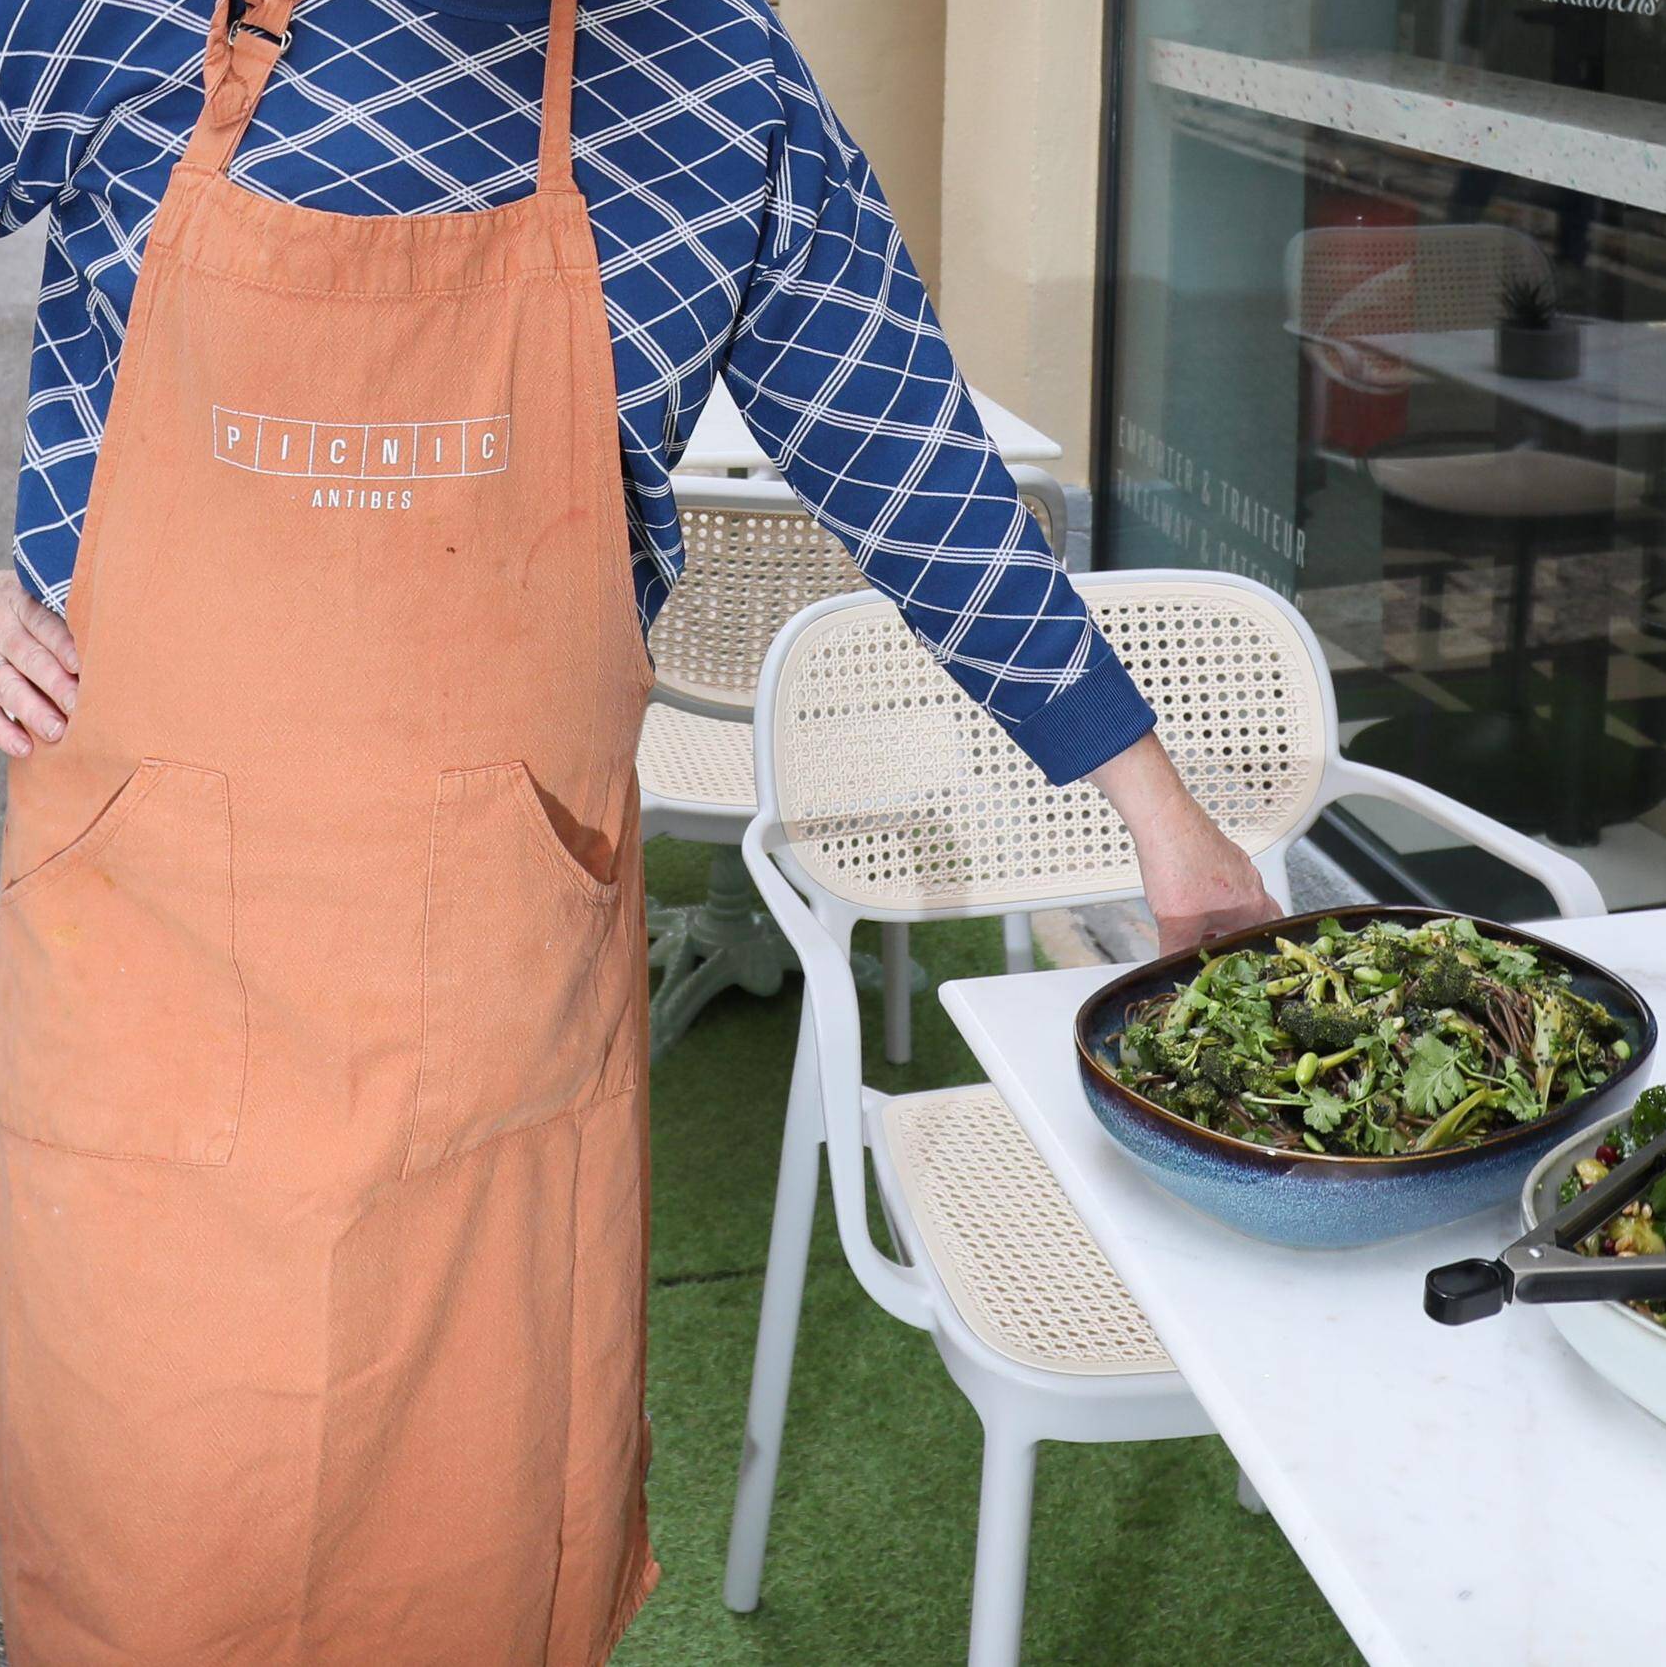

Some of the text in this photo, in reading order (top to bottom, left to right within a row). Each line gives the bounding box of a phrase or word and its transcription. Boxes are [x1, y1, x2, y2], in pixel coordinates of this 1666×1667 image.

[227, 425, 495, 465] PICNIC
[312, 489, 413, 510] ANTIBES
[1117, 469, 1192, 549] TAKEAWAY
[1119, 416, 1193, 493] EMPORTER
[1220, 481, 1306, 568] TRAITEUR
